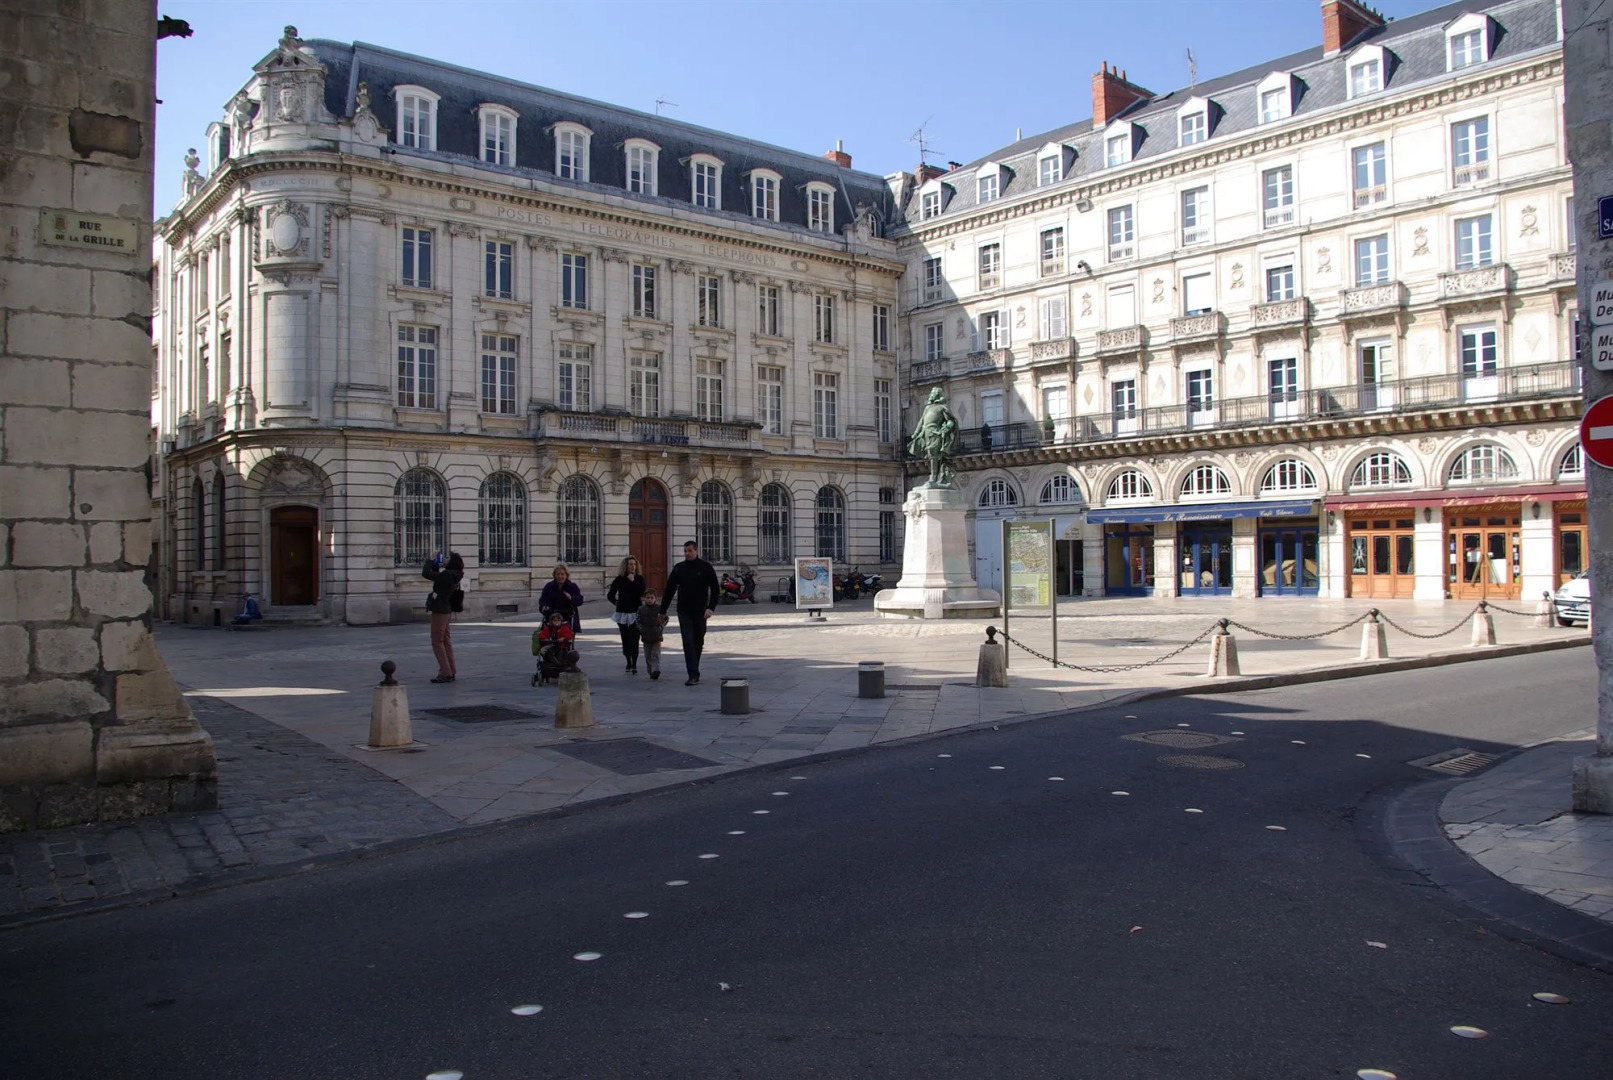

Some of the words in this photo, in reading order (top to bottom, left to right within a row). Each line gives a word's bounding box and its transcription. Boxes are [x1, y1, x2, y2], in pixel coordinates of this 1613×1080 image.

[79, 220, 102, 231] RUE
[83, 234, 125, 247] GRILLE
[496, 206, 553, 226] POSTES
[579, 221, 676, 249] TELEGRAPHES
[701, 243, 777, 266] TELEPHONES
[1596, 305, 1613, 317] De
[660, 434, 690, 446] POSTE
[1176, 512, 1223, 521] Renaissance
